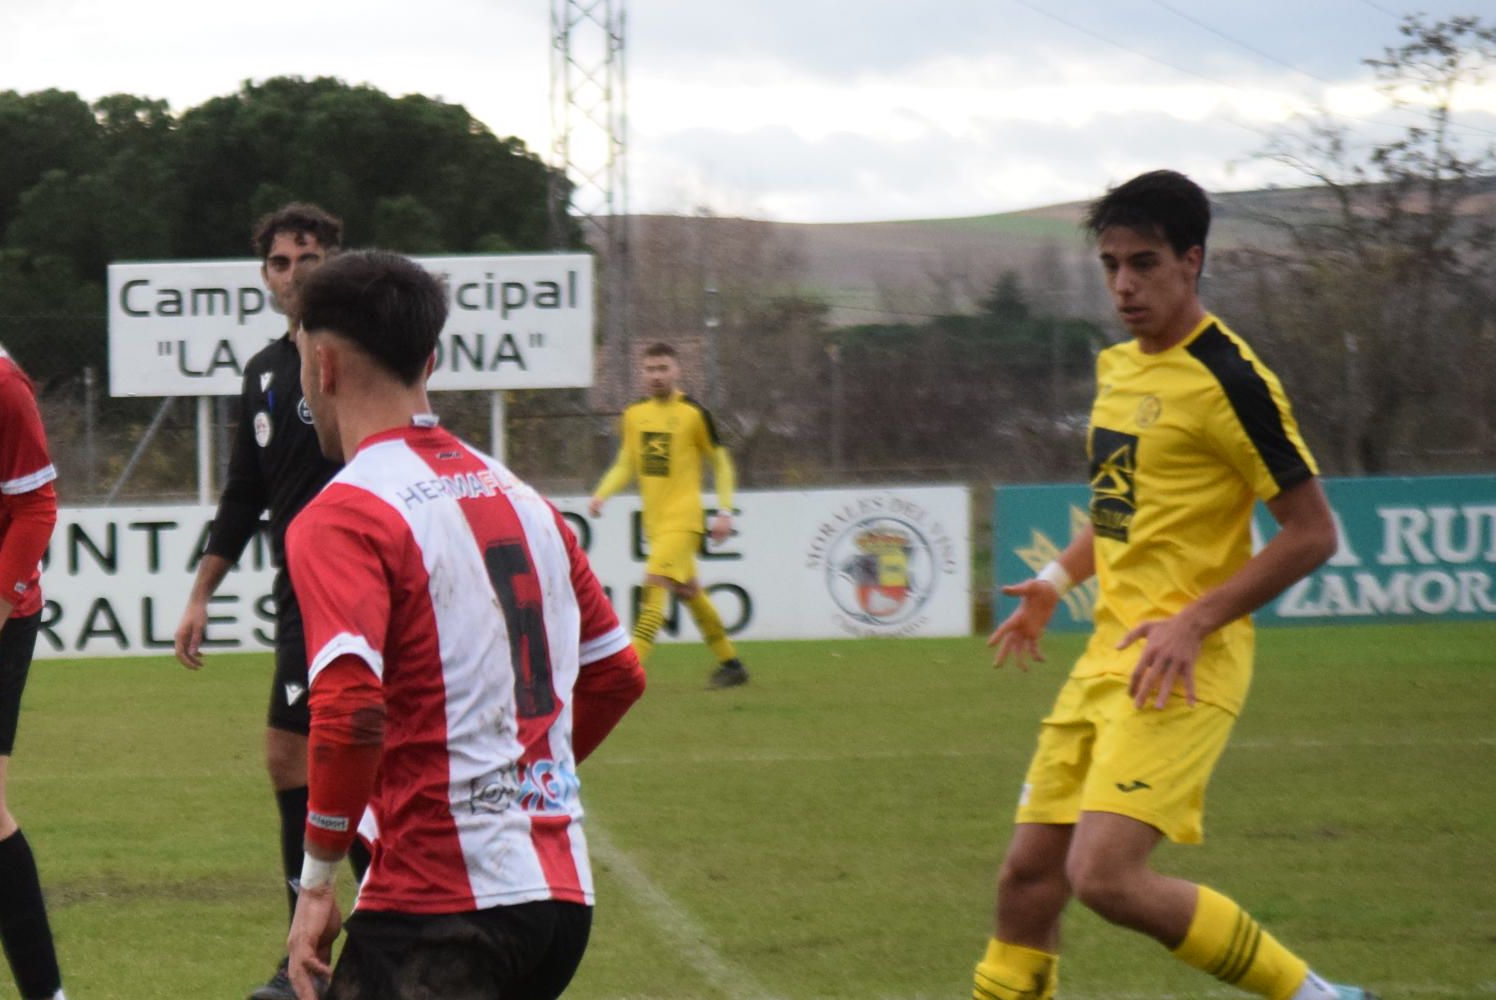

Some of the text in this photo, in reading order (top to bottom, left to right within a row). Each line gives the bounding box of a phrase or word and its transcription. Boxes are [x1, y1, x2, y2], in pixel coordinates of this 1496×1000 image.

[119, 269, 577, 326] Camp icipal
[38, 595, 278, 651] RALES
